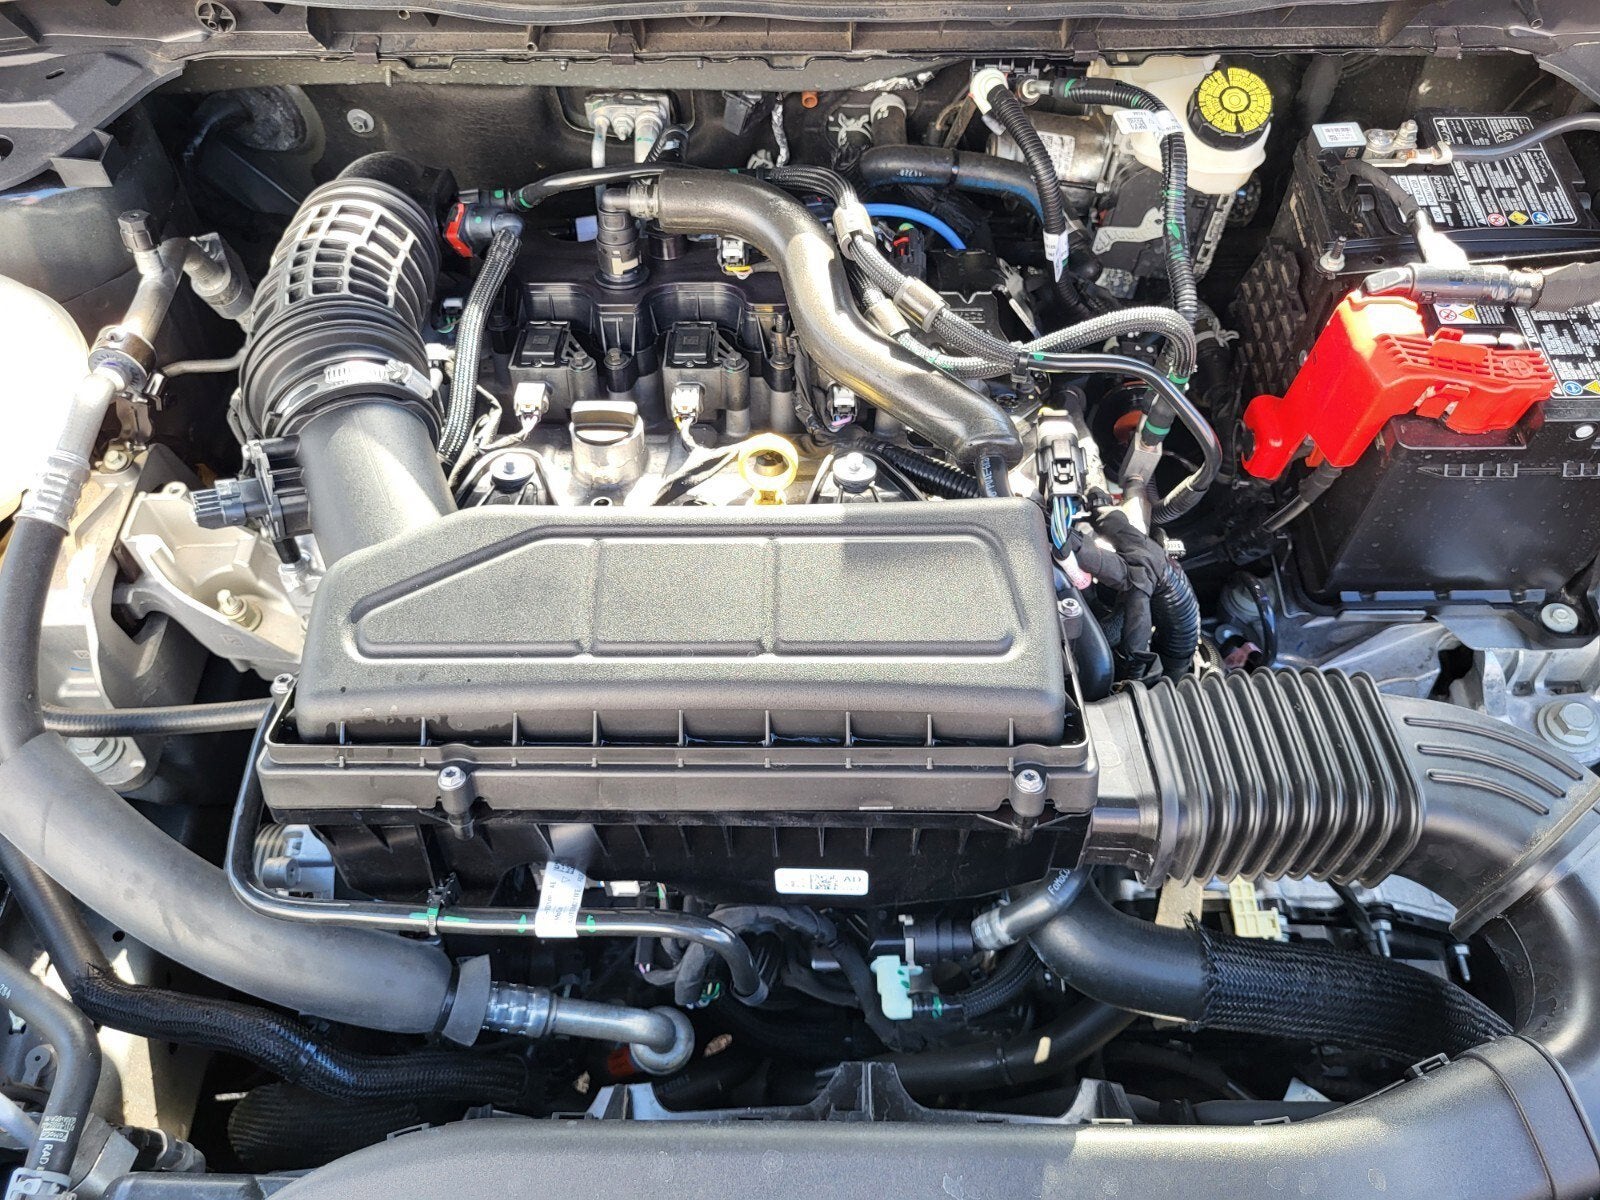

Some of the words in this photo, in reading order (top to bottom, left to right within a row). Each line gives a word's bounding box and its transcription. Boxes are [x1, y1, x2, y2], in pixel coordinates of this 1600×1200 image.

[1433, 176, 1447, 200] FoMoCo
[1047, 868, 1071, 896] FoMoCo
[39, 1143, 54, 1165] RAD
